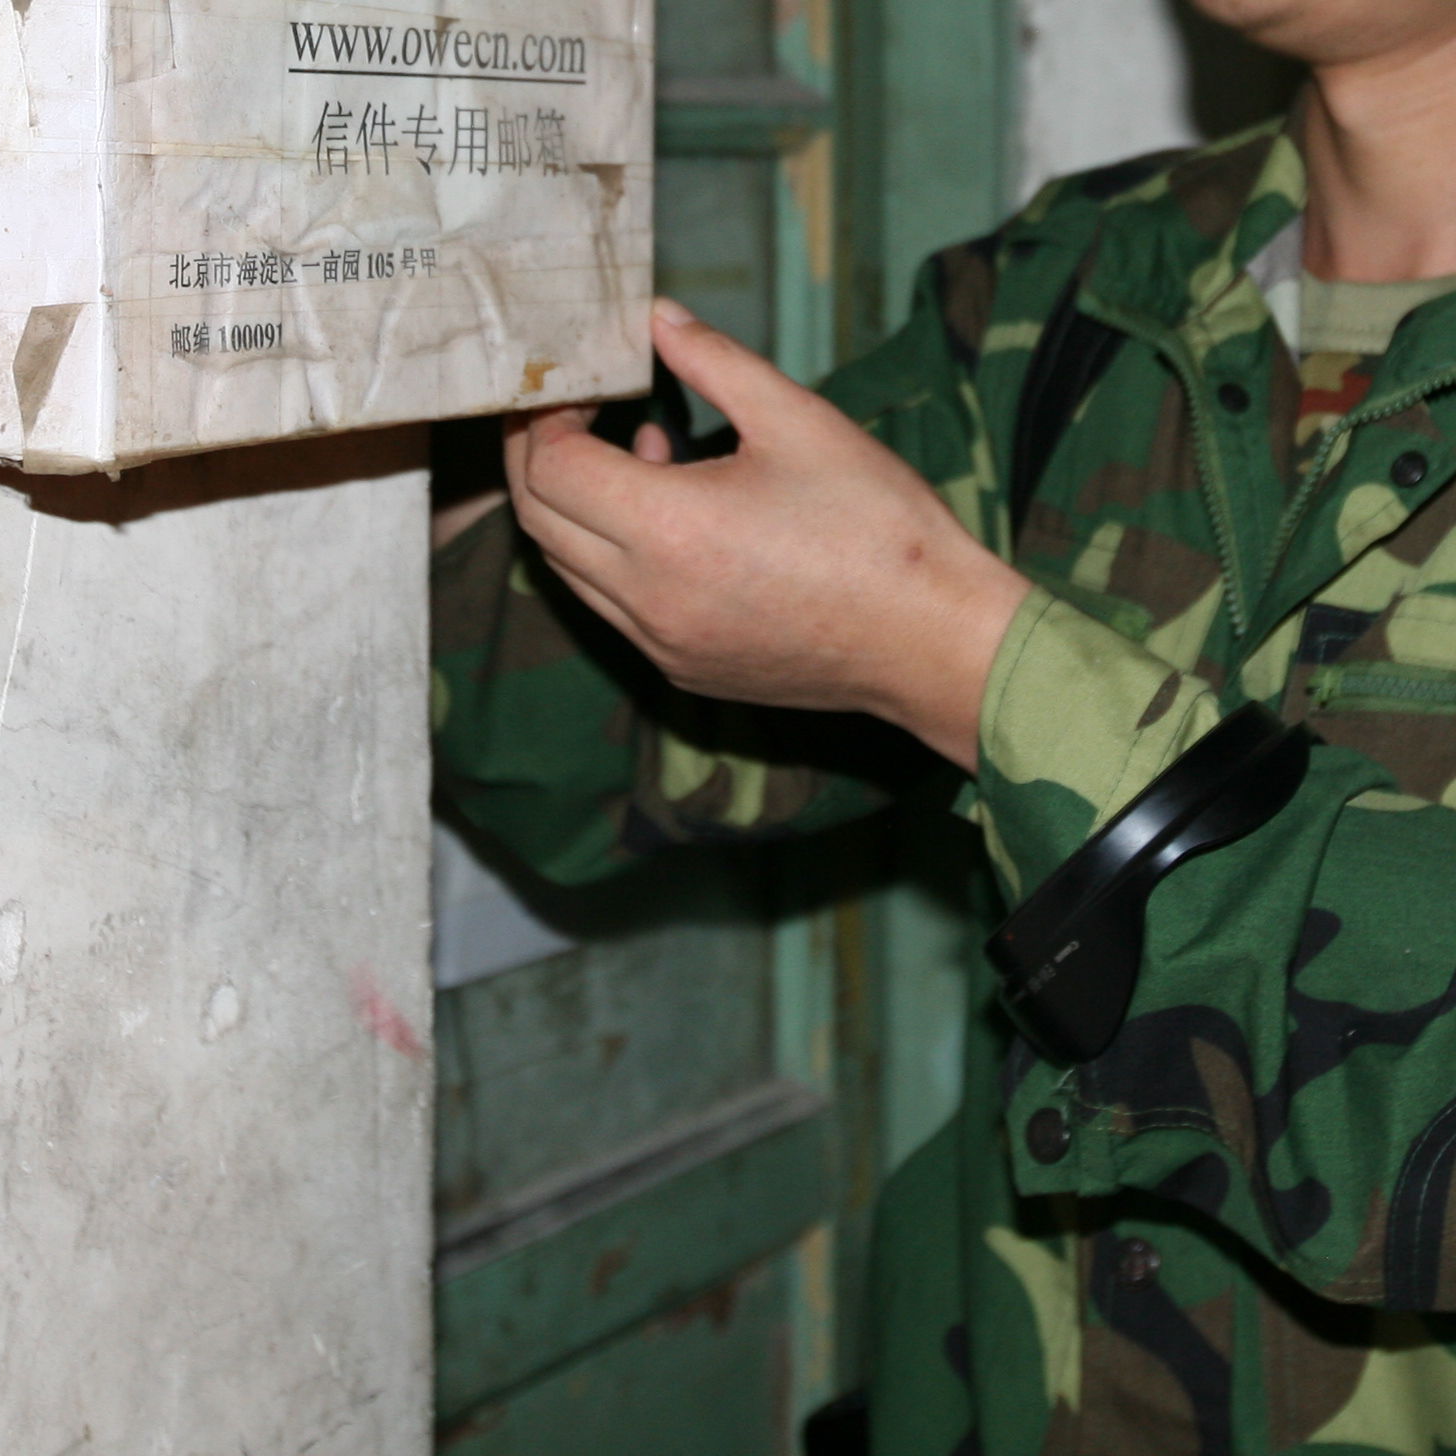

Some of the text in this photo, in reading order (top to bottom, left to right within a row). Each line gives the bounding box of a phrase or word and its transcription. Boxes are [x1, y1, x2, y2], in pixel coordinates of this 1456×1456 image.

[288, 21, 586, 75] www.owecn.com
[311, 100, 569, 178] 信件专用邮箱
